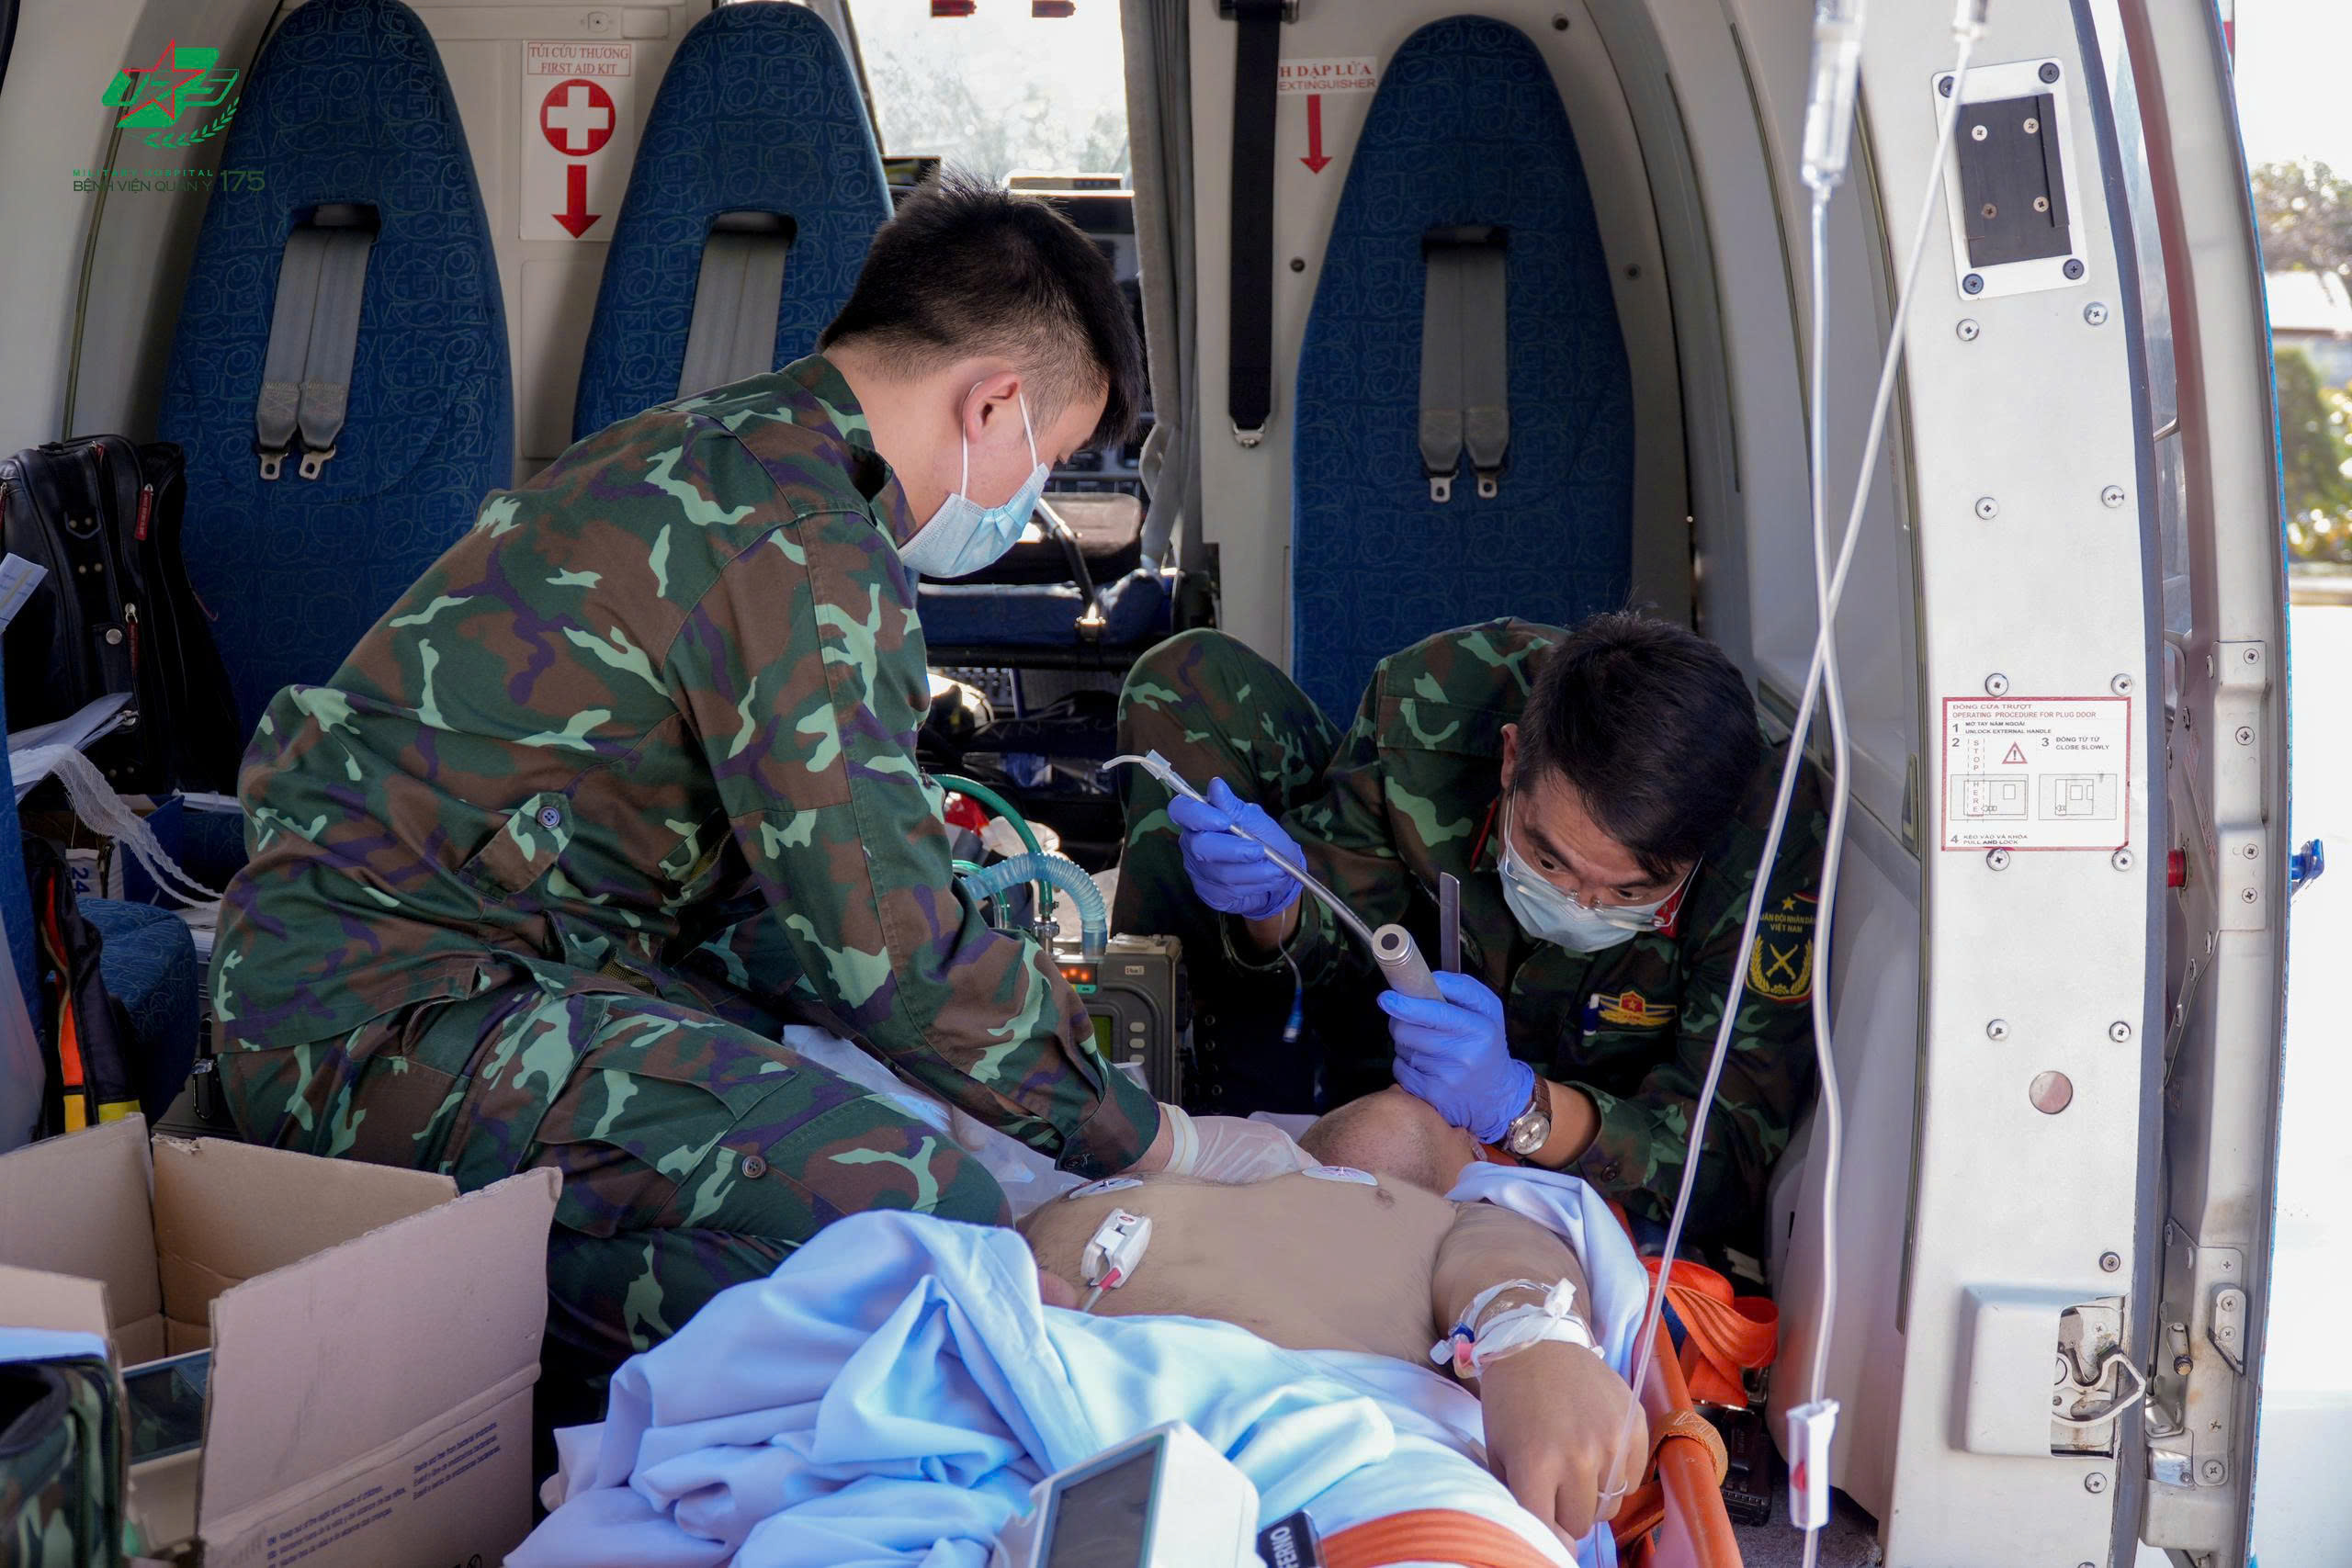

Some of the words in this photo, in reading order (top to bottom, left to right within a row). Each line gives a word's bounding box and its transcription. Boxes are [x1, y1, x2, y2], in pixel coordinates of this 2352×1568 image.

[530, 43, 548, 58] TÚI
[580, 46, 628, 60] THƯƠNG
[541, 62, 572, 73] FIRST
[575, 62, 595, 74] AID
[598, 63, 618, 74] KIT
[1278, 78, 1376, 91] EXTINGUISHER
[1952, 723, 1959, 733] 1
[1951, 738, 1960, 748] 2
[2041, 737, 2050, 747] 3
[1951, 834, 1959, 844] 4
